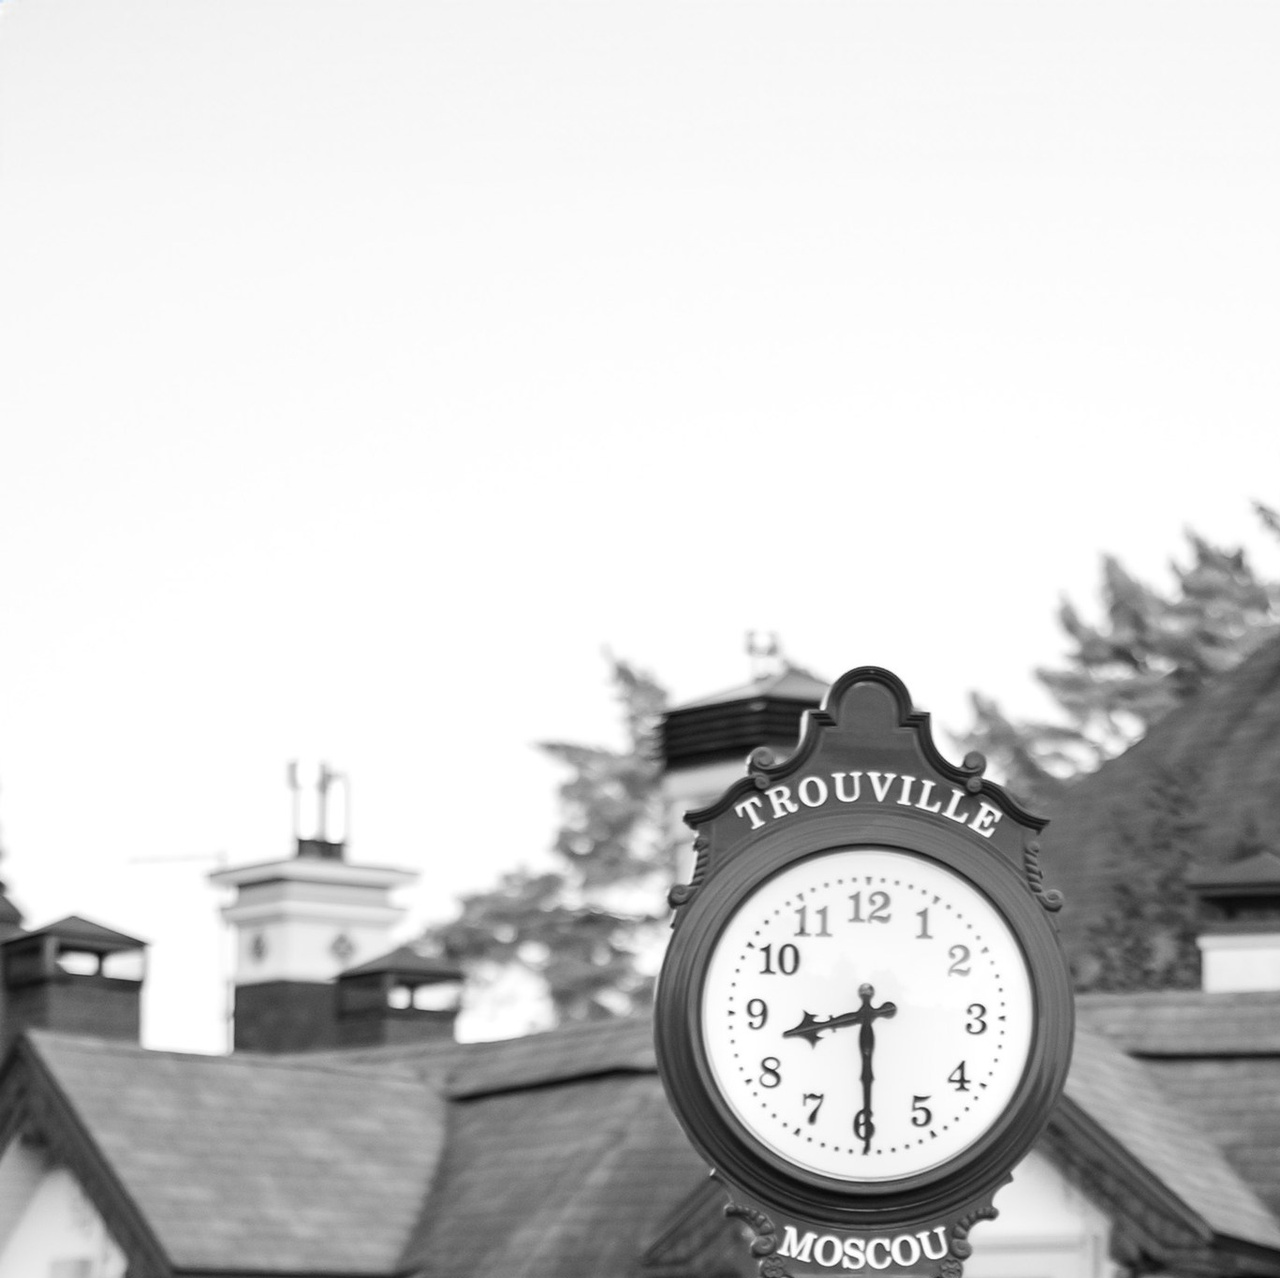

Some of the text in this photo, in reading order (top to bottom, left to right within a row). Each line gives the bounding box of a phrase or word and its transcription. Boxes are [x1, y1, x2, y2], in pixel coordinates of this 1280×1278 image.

[735, 771, 1003, 839] TROUVILLE
[795, 906, 832, 938] 11
[847, 891, 892, 924] 12
[915, 907, 934, 939] 1
[759, 943, 801, 976] 10
[947, 944, 971, 976] 2
[746, 998, 768, 1030] 9
[965, 1003, 988, 1036] 3
[759, 1056, 781, 1089] 8
[947, 1060, 971, 1092] 4
[802, 1093, 824, 1125] 7
[853, 1108, 875, 1141] 6
[912, 1095, 932, 1128] 5
[777, 1226, 949, 1270] MOSCOU
